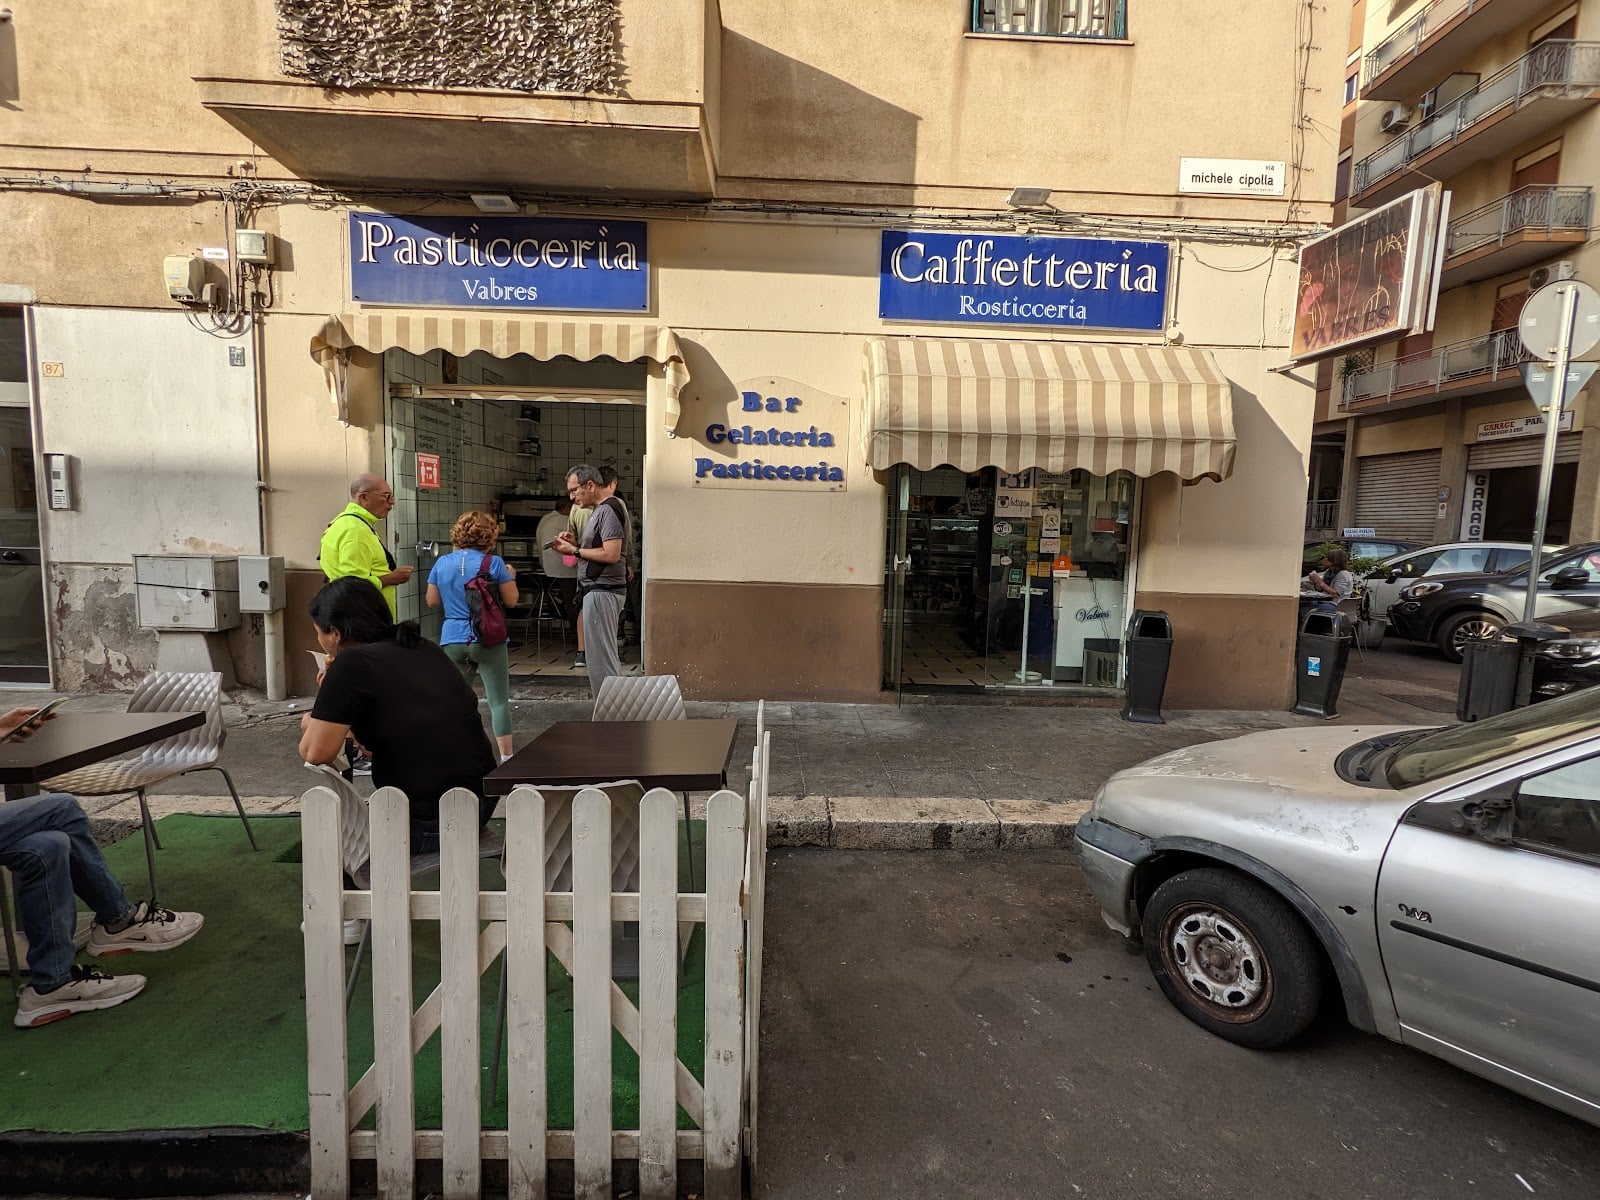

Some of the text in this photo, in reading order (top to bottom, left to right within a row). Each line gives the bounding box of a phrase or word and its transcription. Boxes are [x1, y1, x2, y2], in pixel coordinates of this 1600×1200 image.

[1191, 172, 1274, 188] michele cipolla
[357, 220, 640, 271] Pasticceria
[890, 239, 1159, 293] Caffetteria
[461, 277, 538, 301] Vabres
[959, 295, 1087, 320] Rosticceria
[45, 364, 60, 375] 87
[741, 391, 801, 413] Bar
[705, 423, 834, 448] Gelateria
[1483, 420, 1515, 432] GARAGE
[694, 457, 844, 482] Pasticceria
[1468, 475, 1486, 541] GARAG
